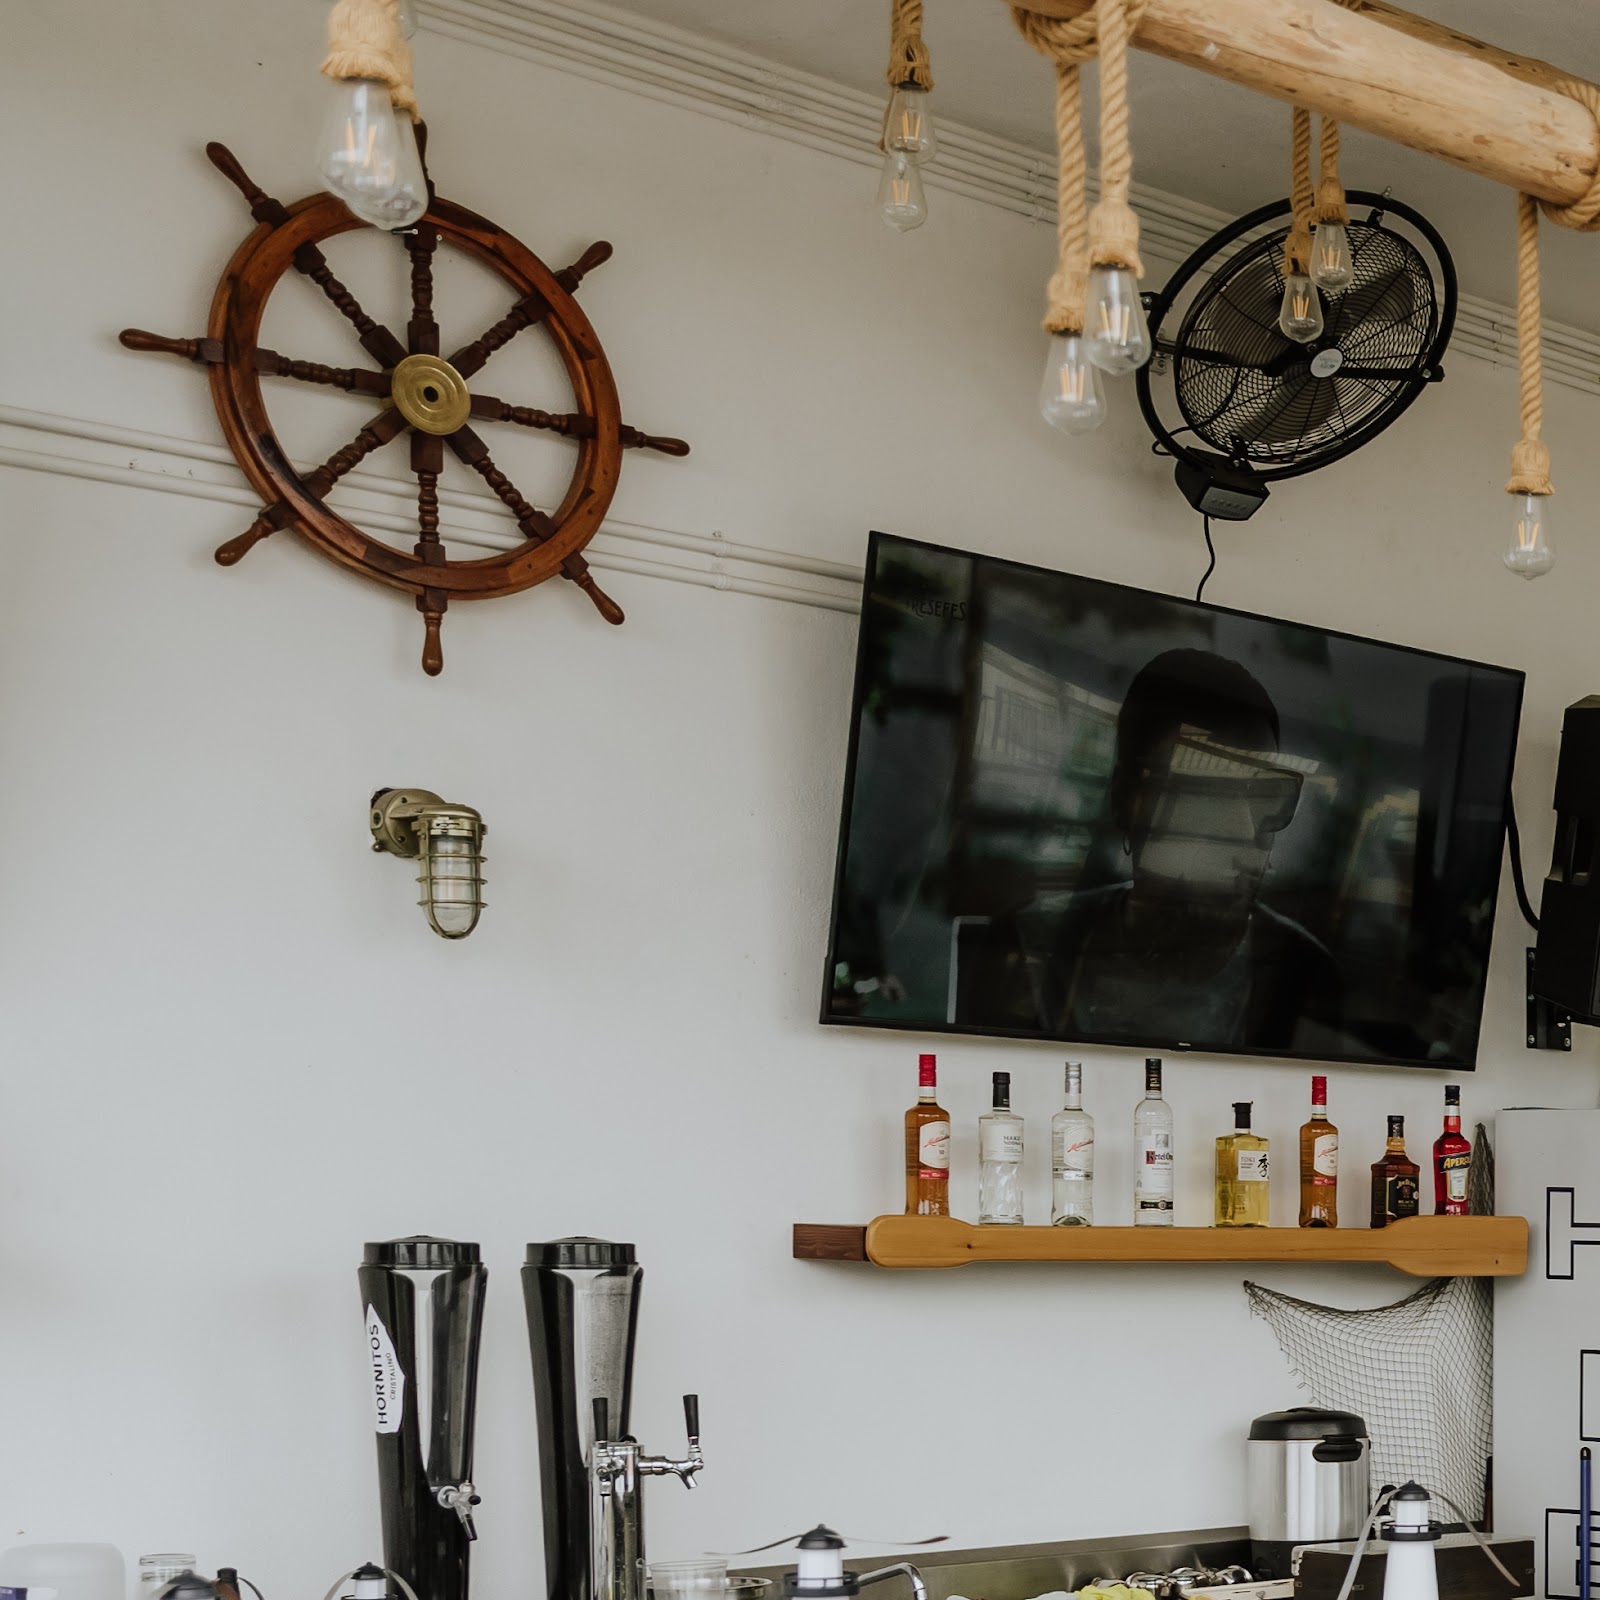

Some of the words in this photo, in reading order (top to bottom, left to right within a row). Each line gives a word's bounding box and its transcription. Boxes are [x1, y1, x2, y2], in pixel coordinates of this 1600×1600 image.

[905, 598, 967, 621] RESEFES
[1443, 1156, 1471, 1170] APERO
[369, 1324, 388, 1424] HORNITOS
[385, 1352, 397, 1400] CRISTALINO
